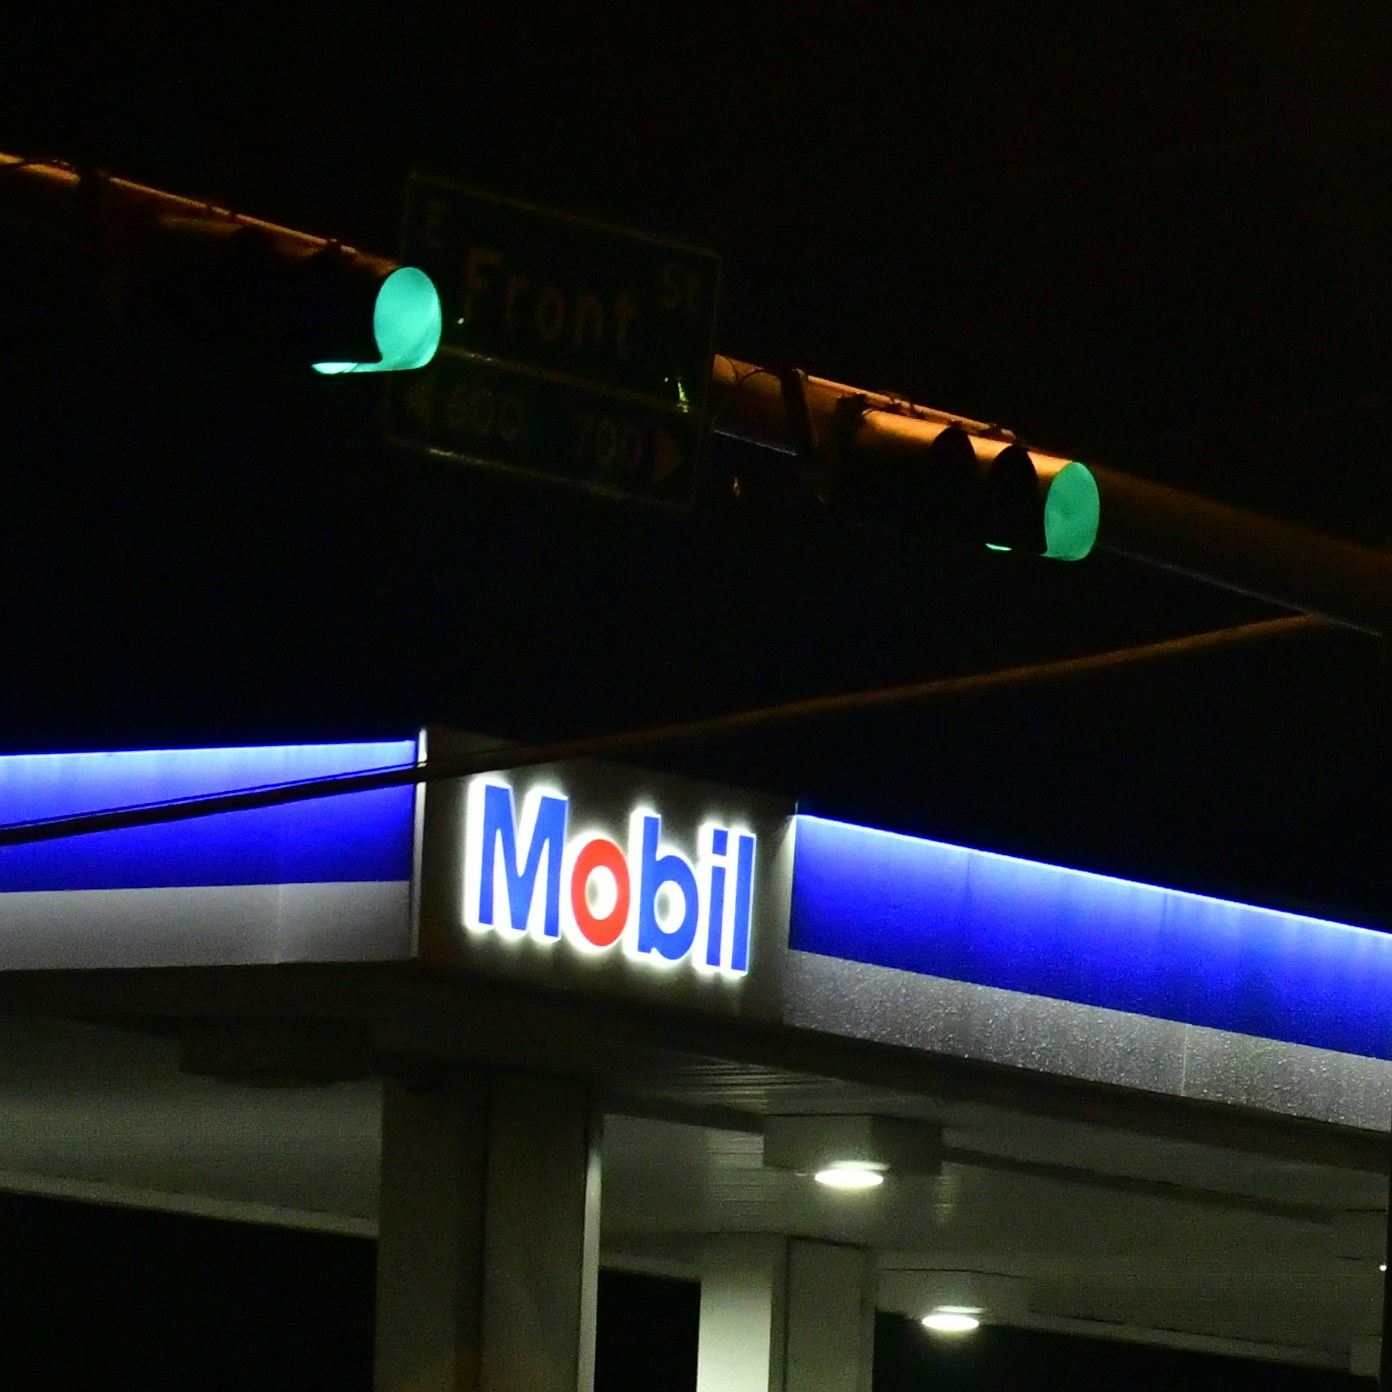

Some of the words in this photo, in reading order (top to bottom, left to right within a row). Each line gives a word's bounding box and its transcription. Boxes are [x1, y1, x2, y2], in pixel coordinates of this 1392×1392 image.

[462, 247, 637, 362] Front
[658, 261, 702, 315] St
[470, 782, 757, 975] Mobil
